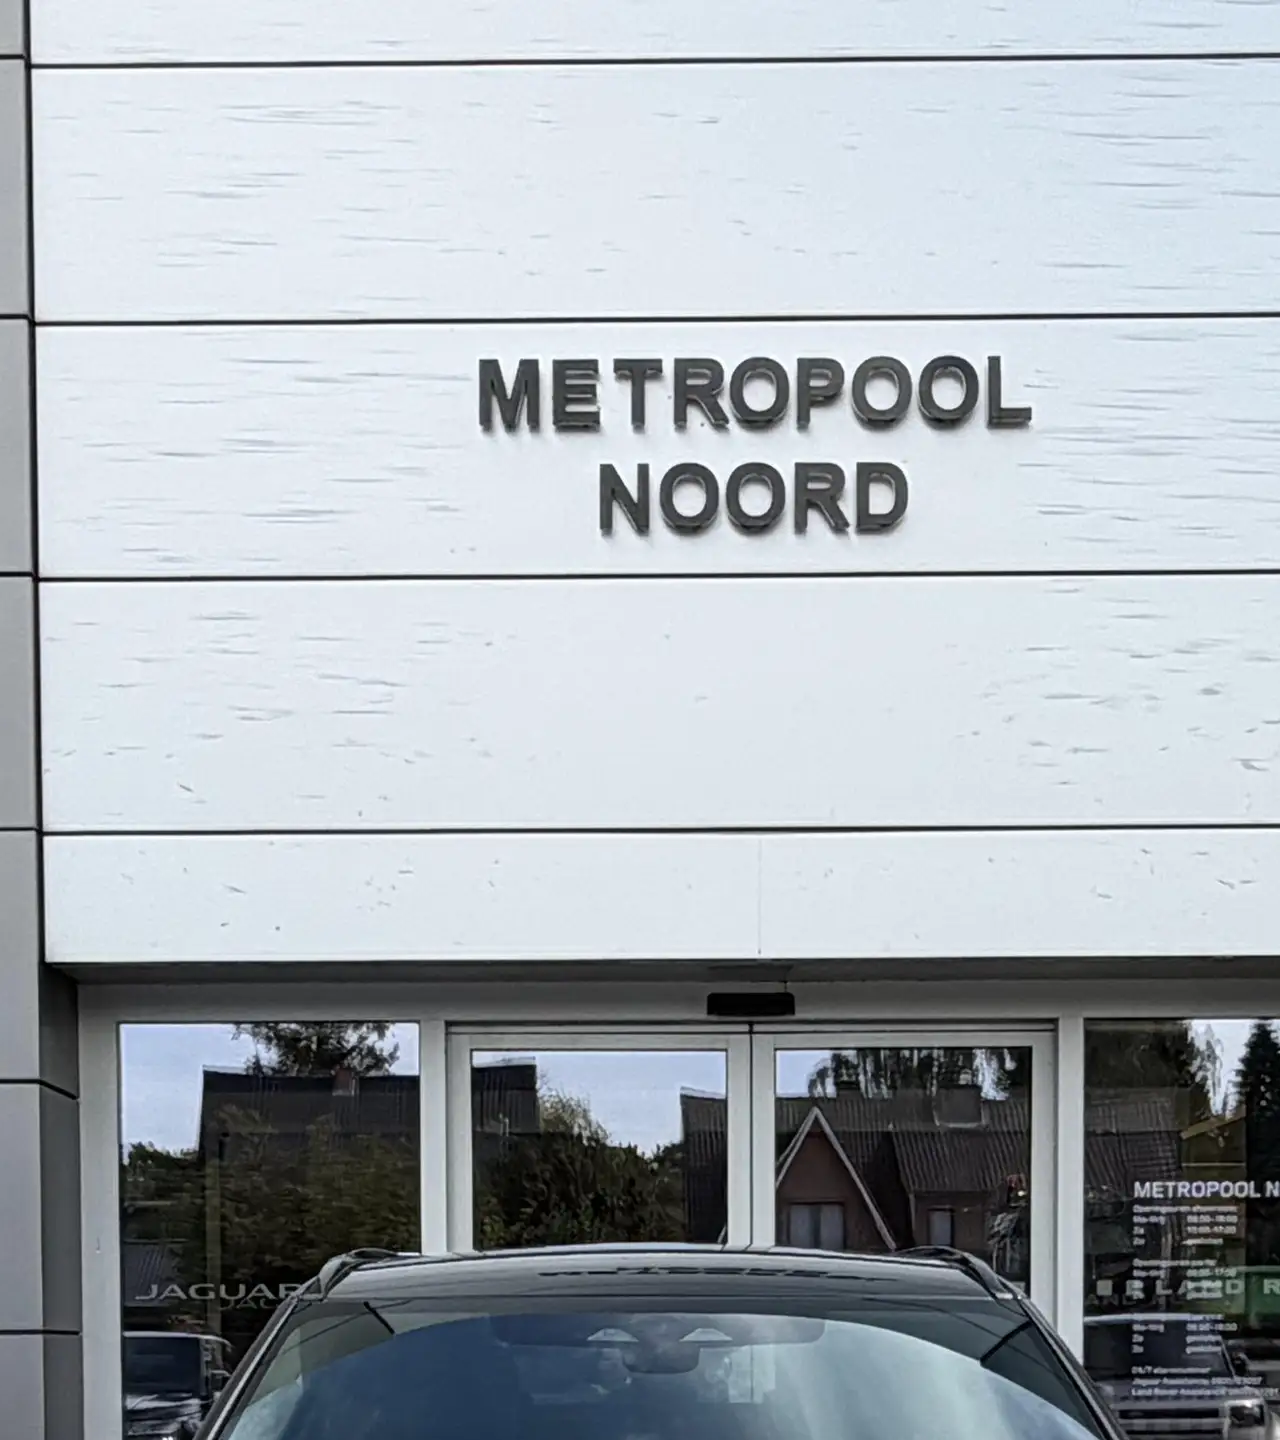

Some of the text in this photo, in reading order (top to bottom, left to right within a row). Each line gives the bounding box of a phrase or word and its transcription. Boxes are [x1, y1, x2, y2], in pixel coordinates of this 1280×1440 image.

[478, 355, 1032, 430] METROPOOL
[600, 462, 909, 535] NOORD
[1133, 1181, 1261, 1198] METROPOOL
